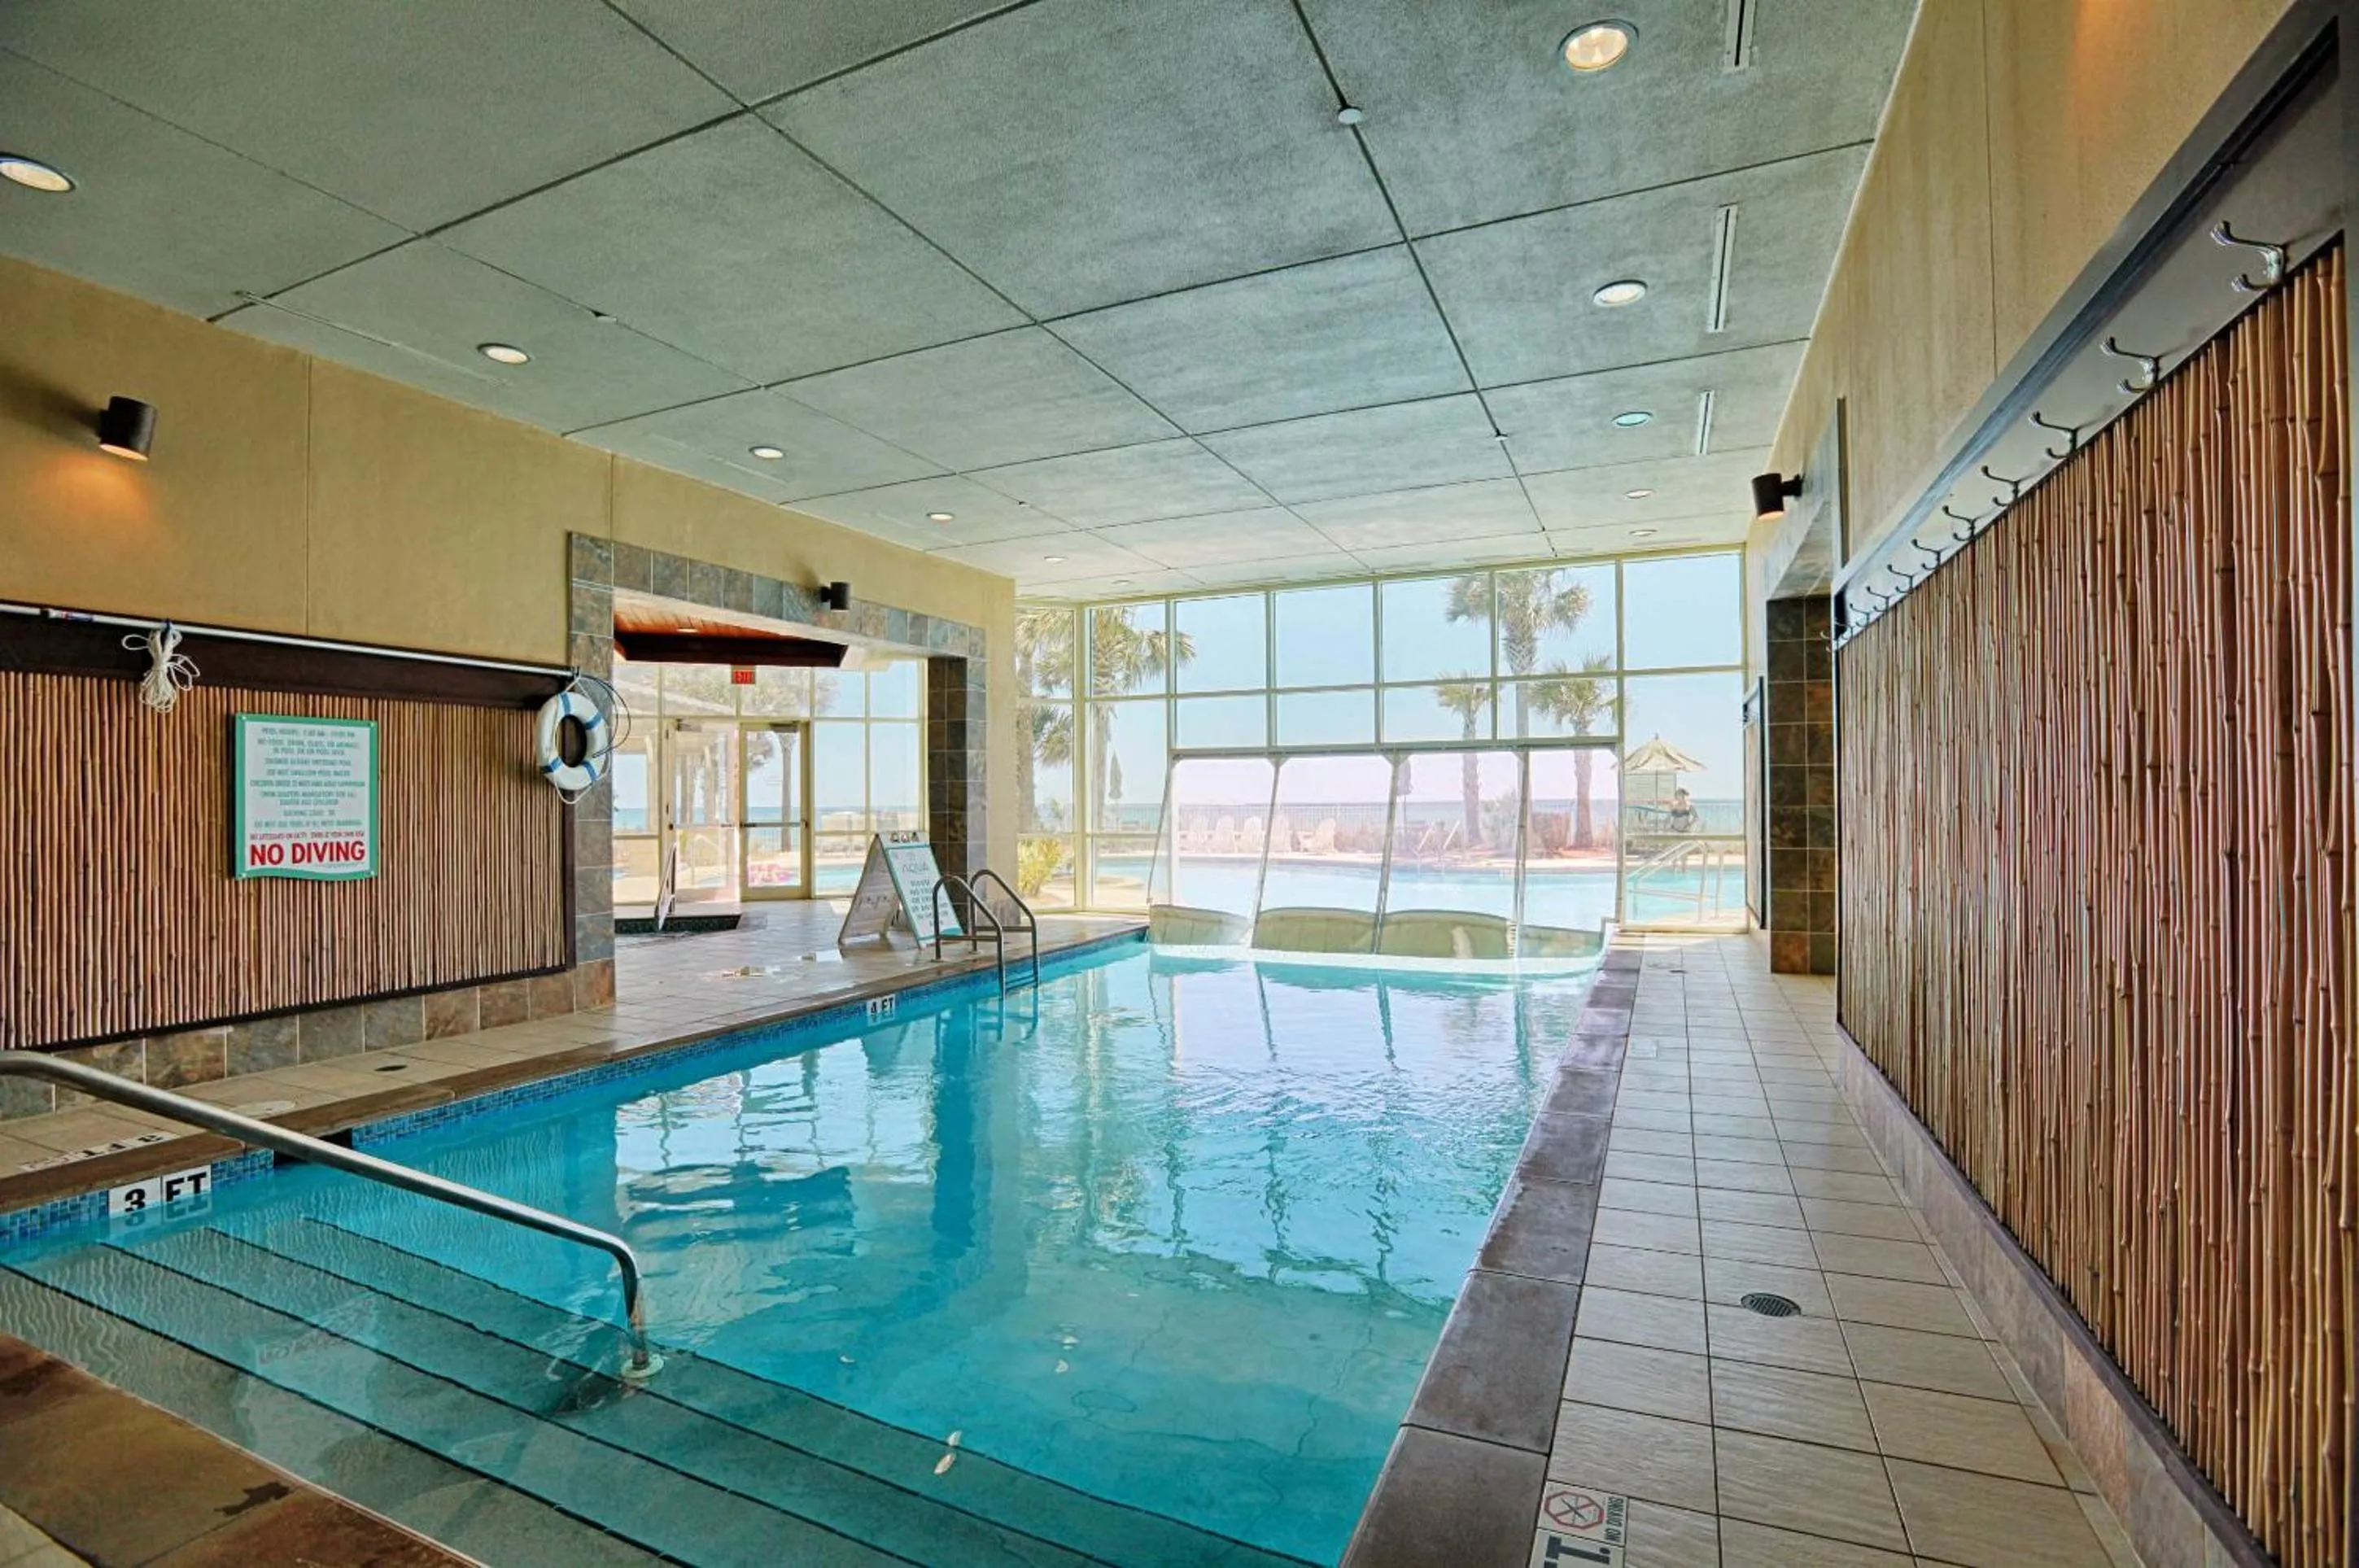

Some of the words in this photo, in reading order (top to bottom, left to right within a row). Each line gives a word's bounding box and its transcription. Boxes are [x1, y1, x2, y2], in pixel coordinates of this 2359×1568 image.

[251, 843, 284, 866] NO
[291, 841, 365, 864] DIVING
[871, 1001, 877, 1013] 4
[881, 997, 894, 1011] FT
[125, 1188, 146, 1212] 3
[165, 1172, 208, 1202] FT
[1606, 1496, 1625, 1527] DIVING
[1605, 1529, 1623, 1542] NO
